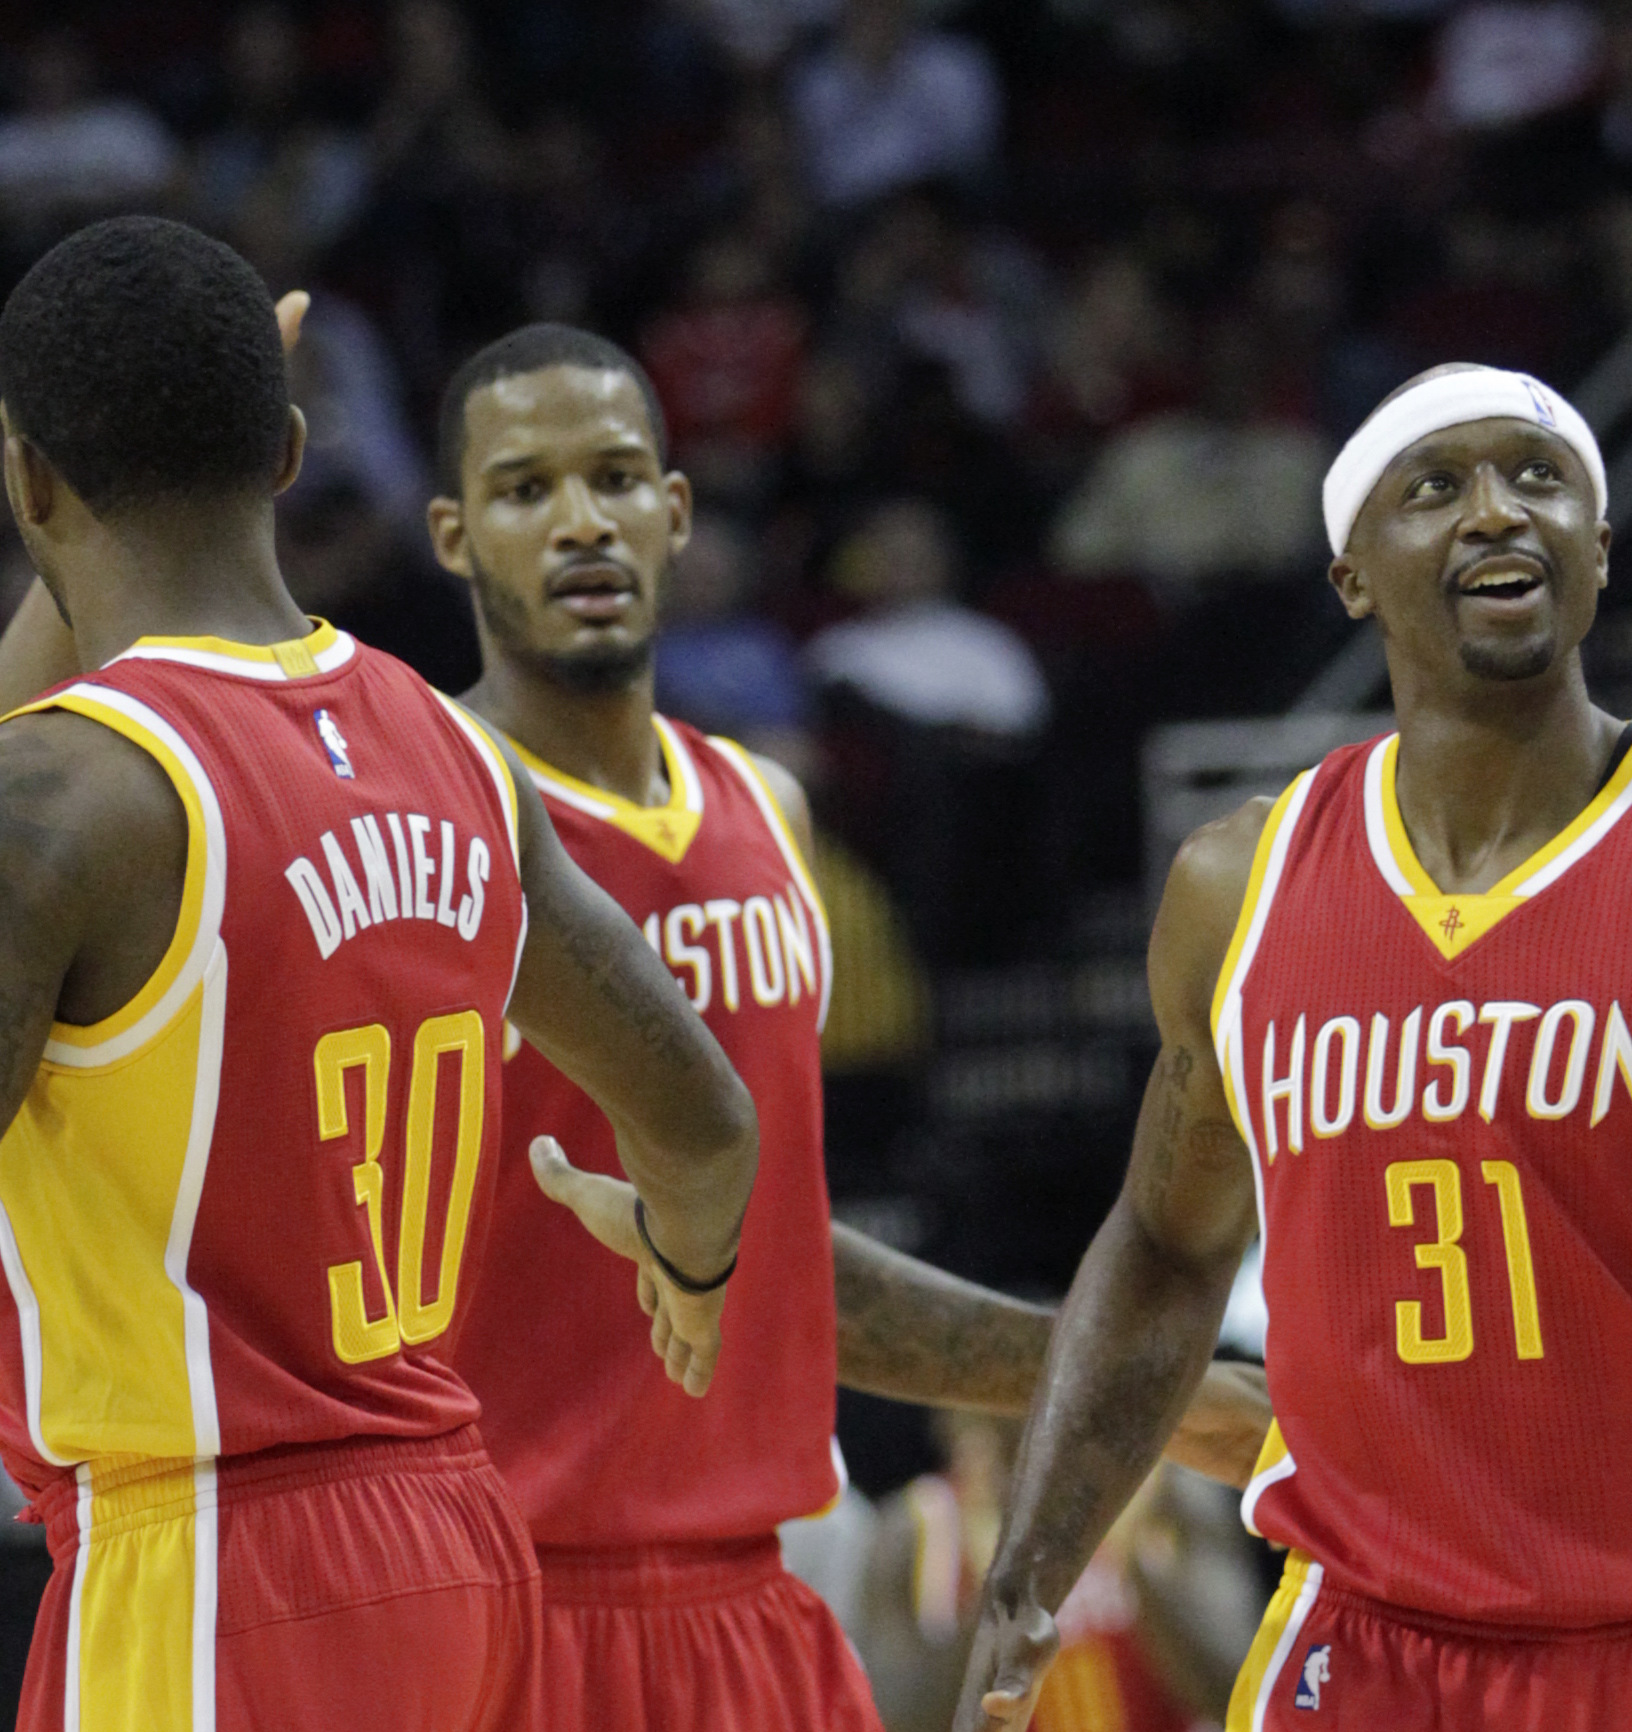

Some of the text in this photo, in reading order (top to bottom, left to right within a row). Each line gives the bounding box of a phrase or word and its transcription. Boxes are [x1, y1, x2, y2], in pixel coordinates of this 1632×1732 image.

[283, 811, 491, 962] DANIELS
[642, 880, 818, 1014] STON
[313, 1008, 486, 1365] 30
[1384, 1158, 1545, 1366] 31
